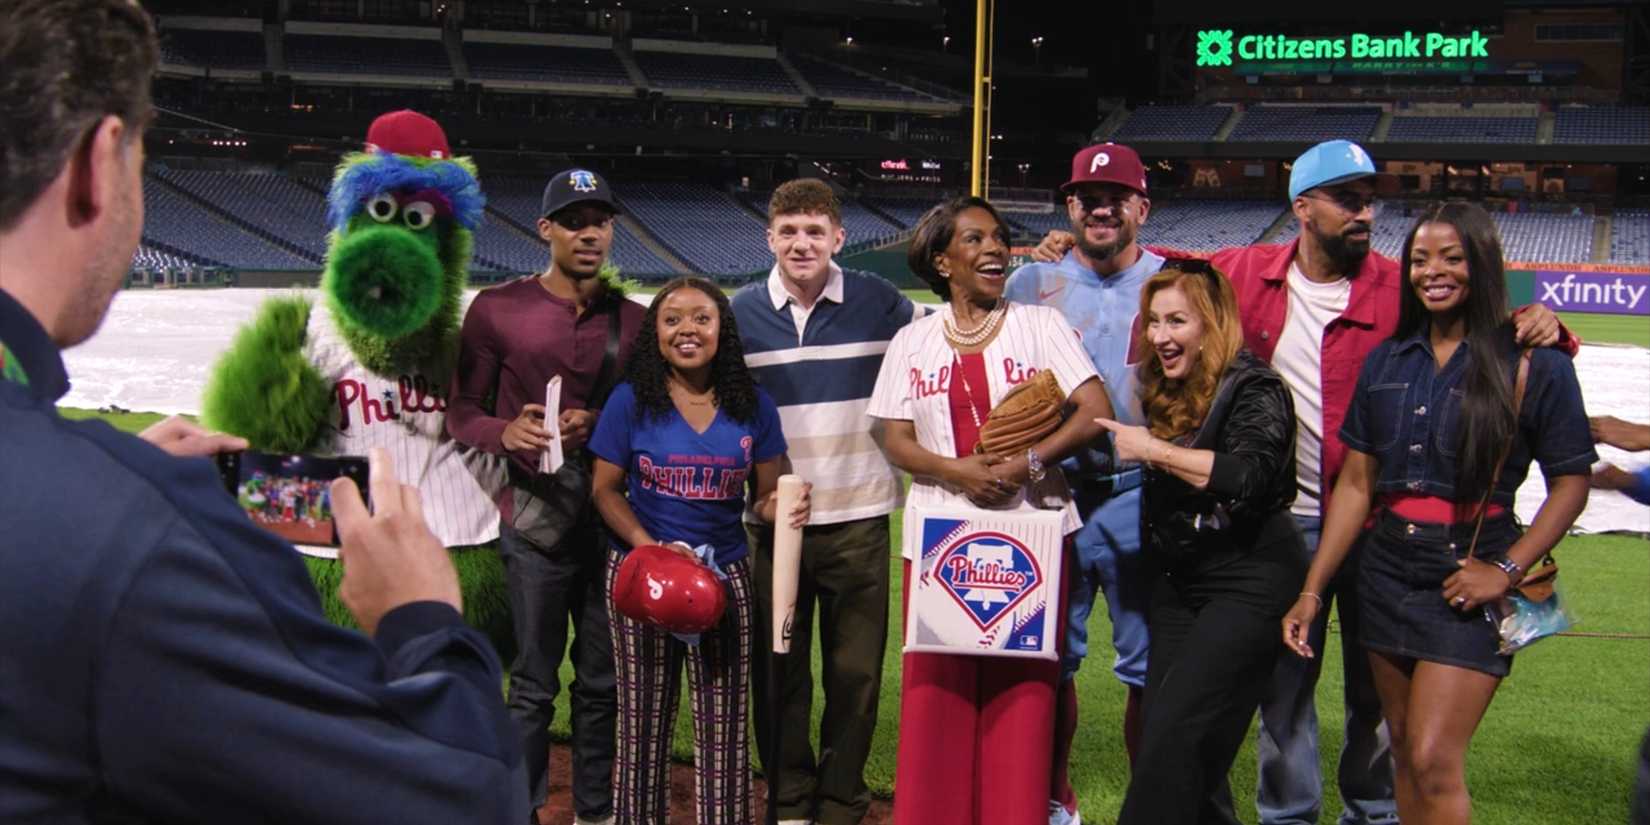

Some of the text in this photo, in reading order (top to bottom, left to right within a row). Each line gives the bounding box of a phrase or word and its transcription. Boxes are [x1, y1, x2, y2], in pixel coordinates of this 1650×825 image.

[1238, 31, 1488, 59] Citizens Bank Park
[1541, 274, 1647, 309] xfinity
[948, 554, 1025, 591] Phillies
